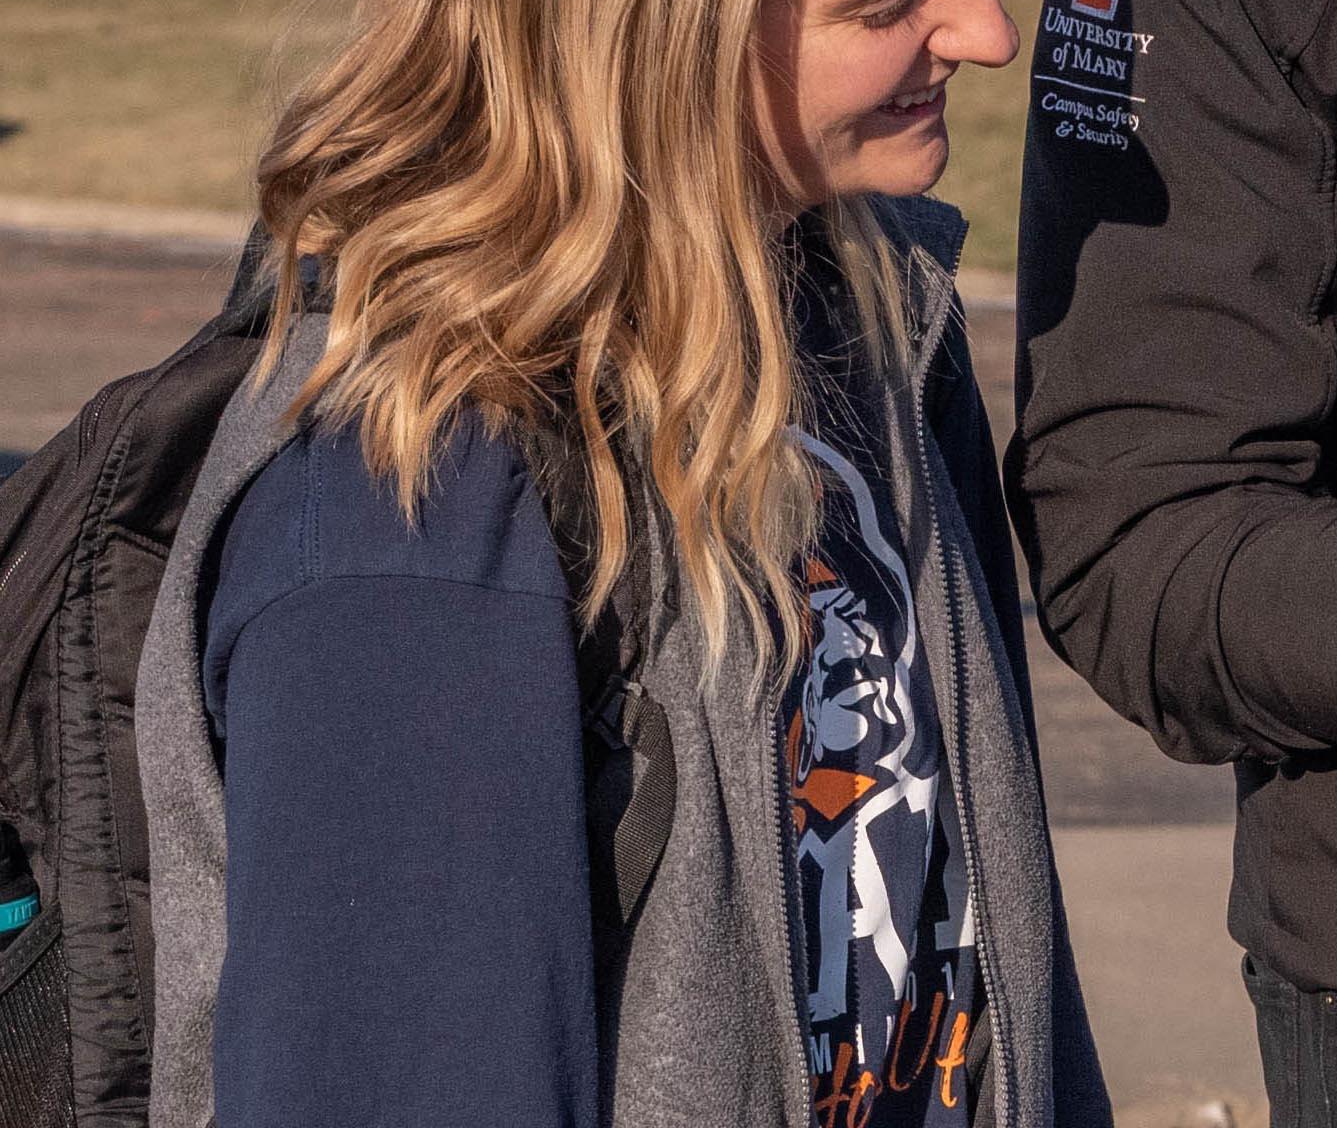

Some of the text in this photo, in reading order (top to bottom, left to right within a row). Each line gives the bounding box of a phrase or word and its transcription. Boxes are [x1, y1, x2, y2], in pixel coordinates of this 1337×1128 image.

[1045, 7, 1154, 54] UNIVERSITY
[1052, 43, 1127, 80] of MARY
[1041, 92, 1140, 131] Campus Safety
[1055, 121, 1129, 150] & Security
